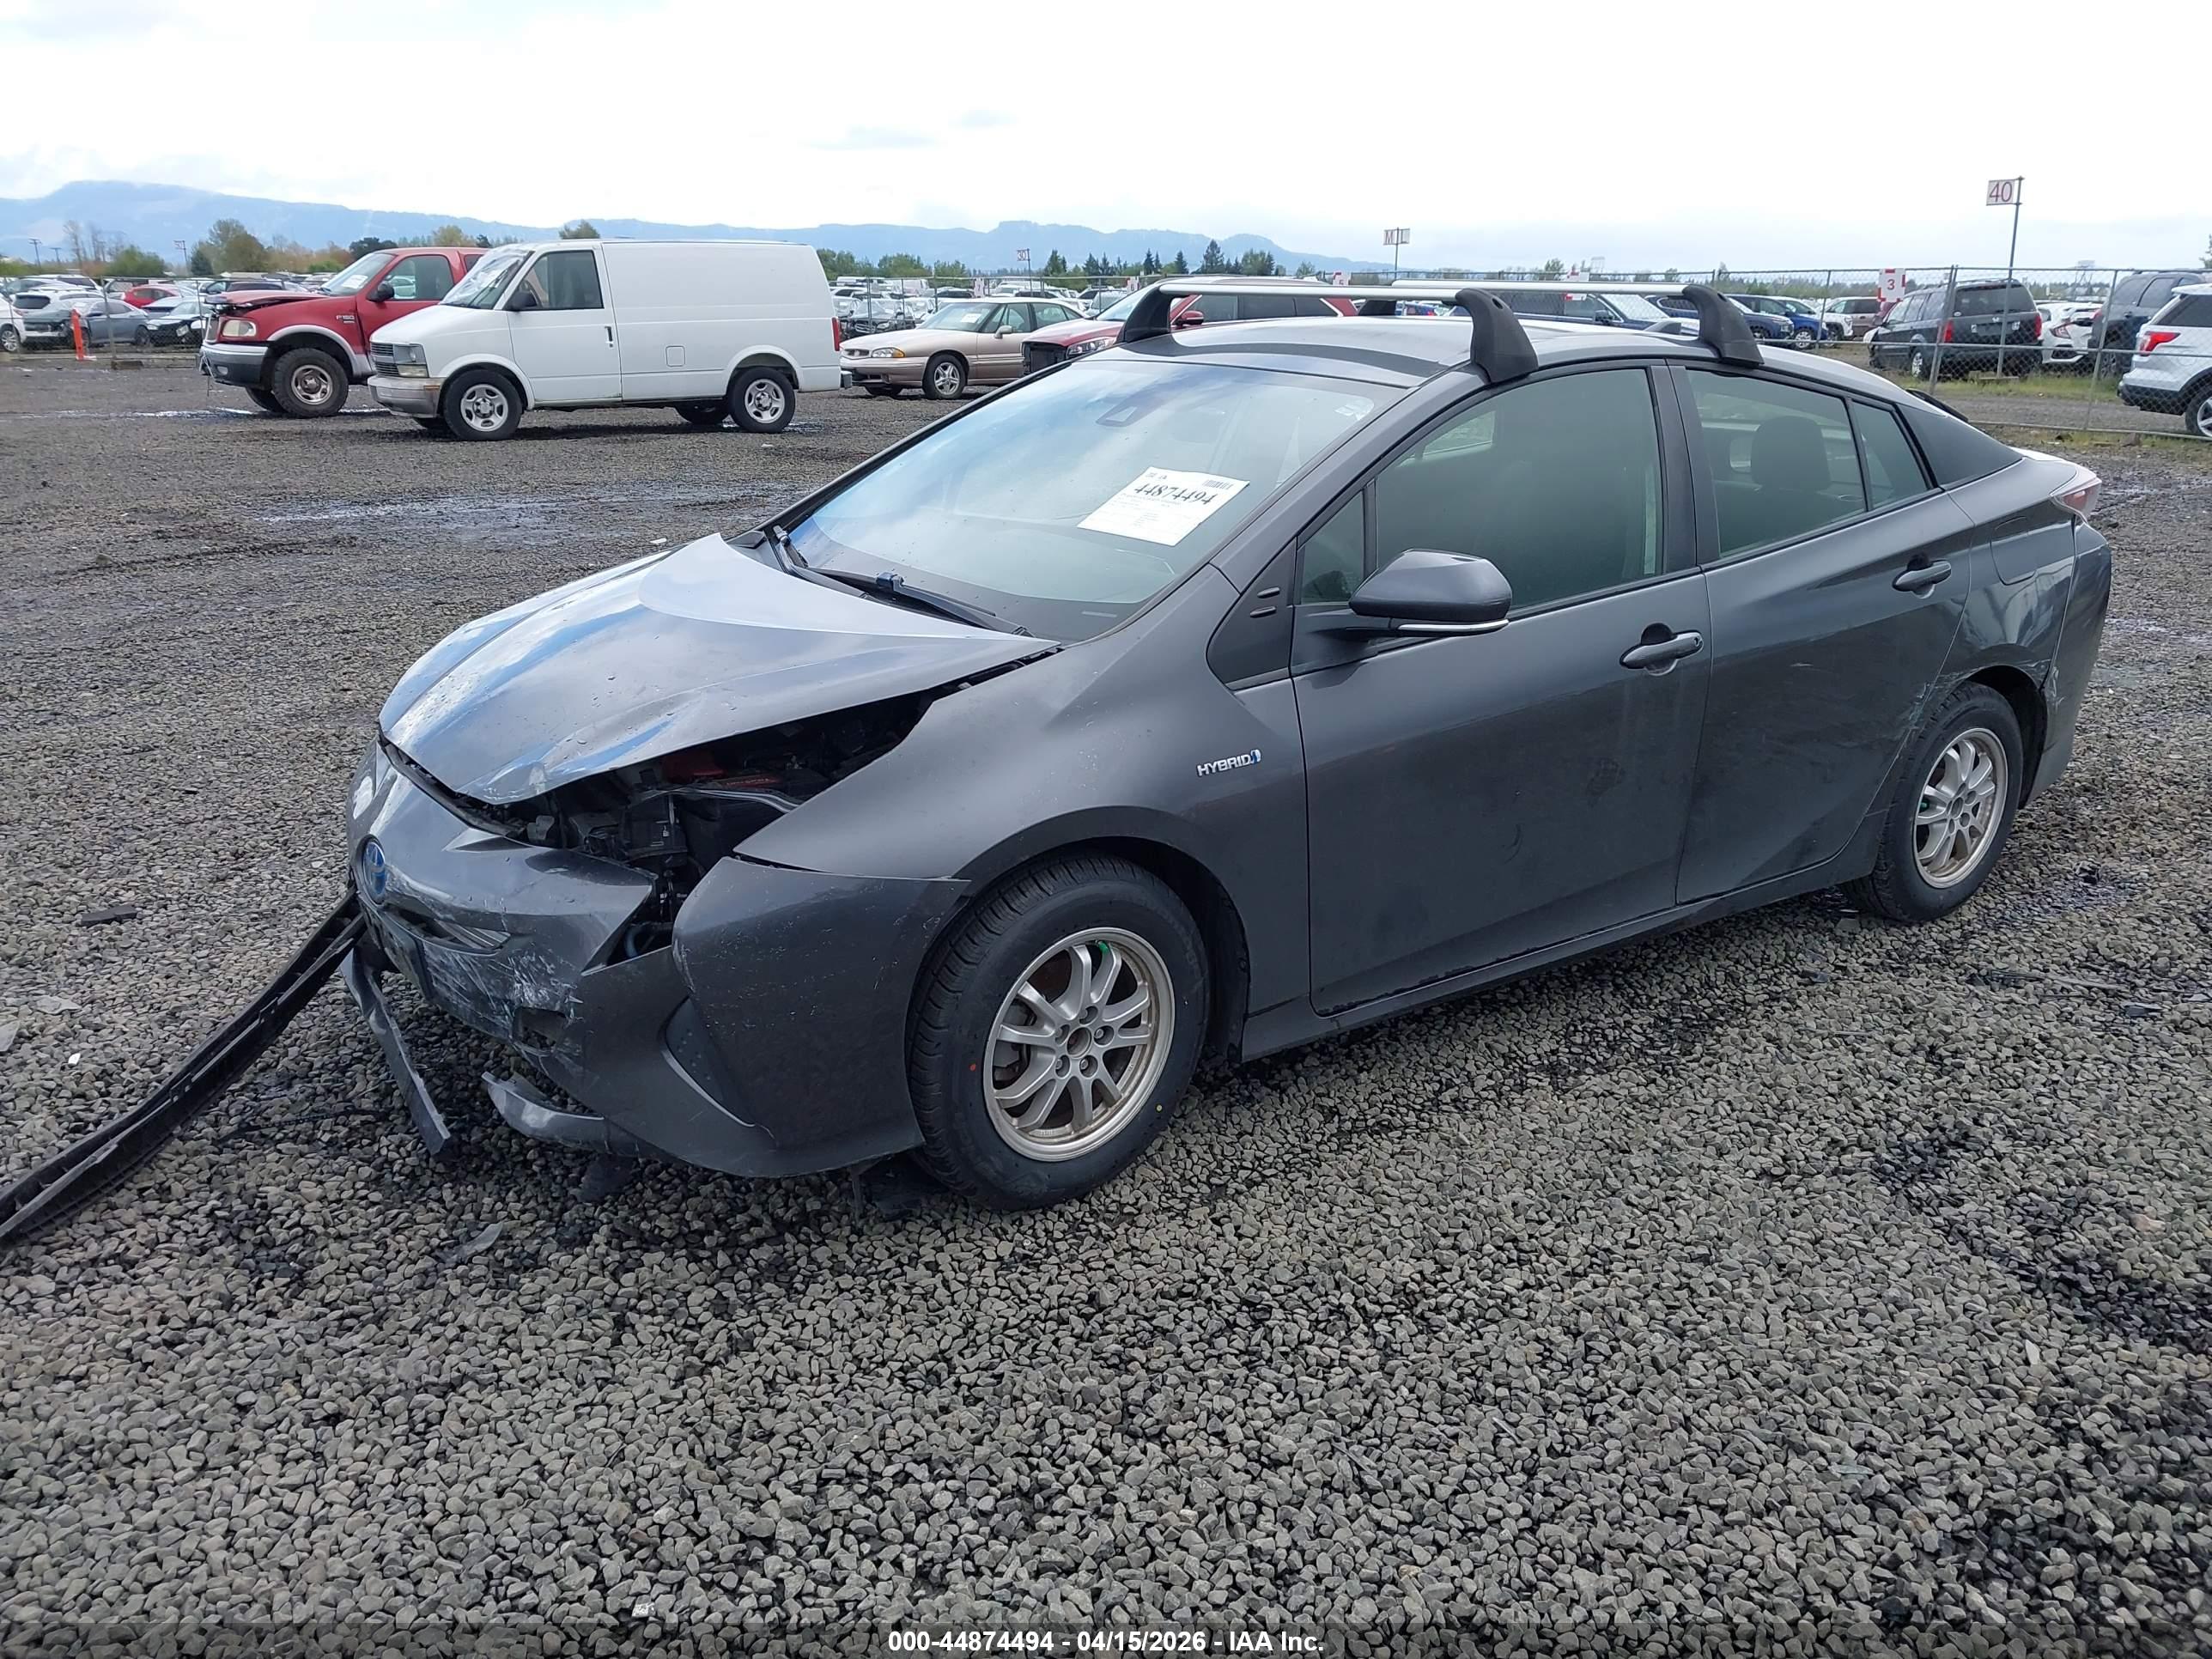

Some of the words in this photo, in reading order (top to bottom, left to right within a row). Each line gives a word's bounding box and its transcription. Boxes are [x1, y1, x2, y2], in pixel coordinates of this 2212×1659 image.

[1989, 181, 2013, 203] 40
[1385, 230, 1394, 245] M
[1018, 250, 1027, 261] 30
[1887, 278, 1895, 290] 3
[1134, 483, 1218, 505] 44874494
[1196, 753, 1252, 777] HYBRID
